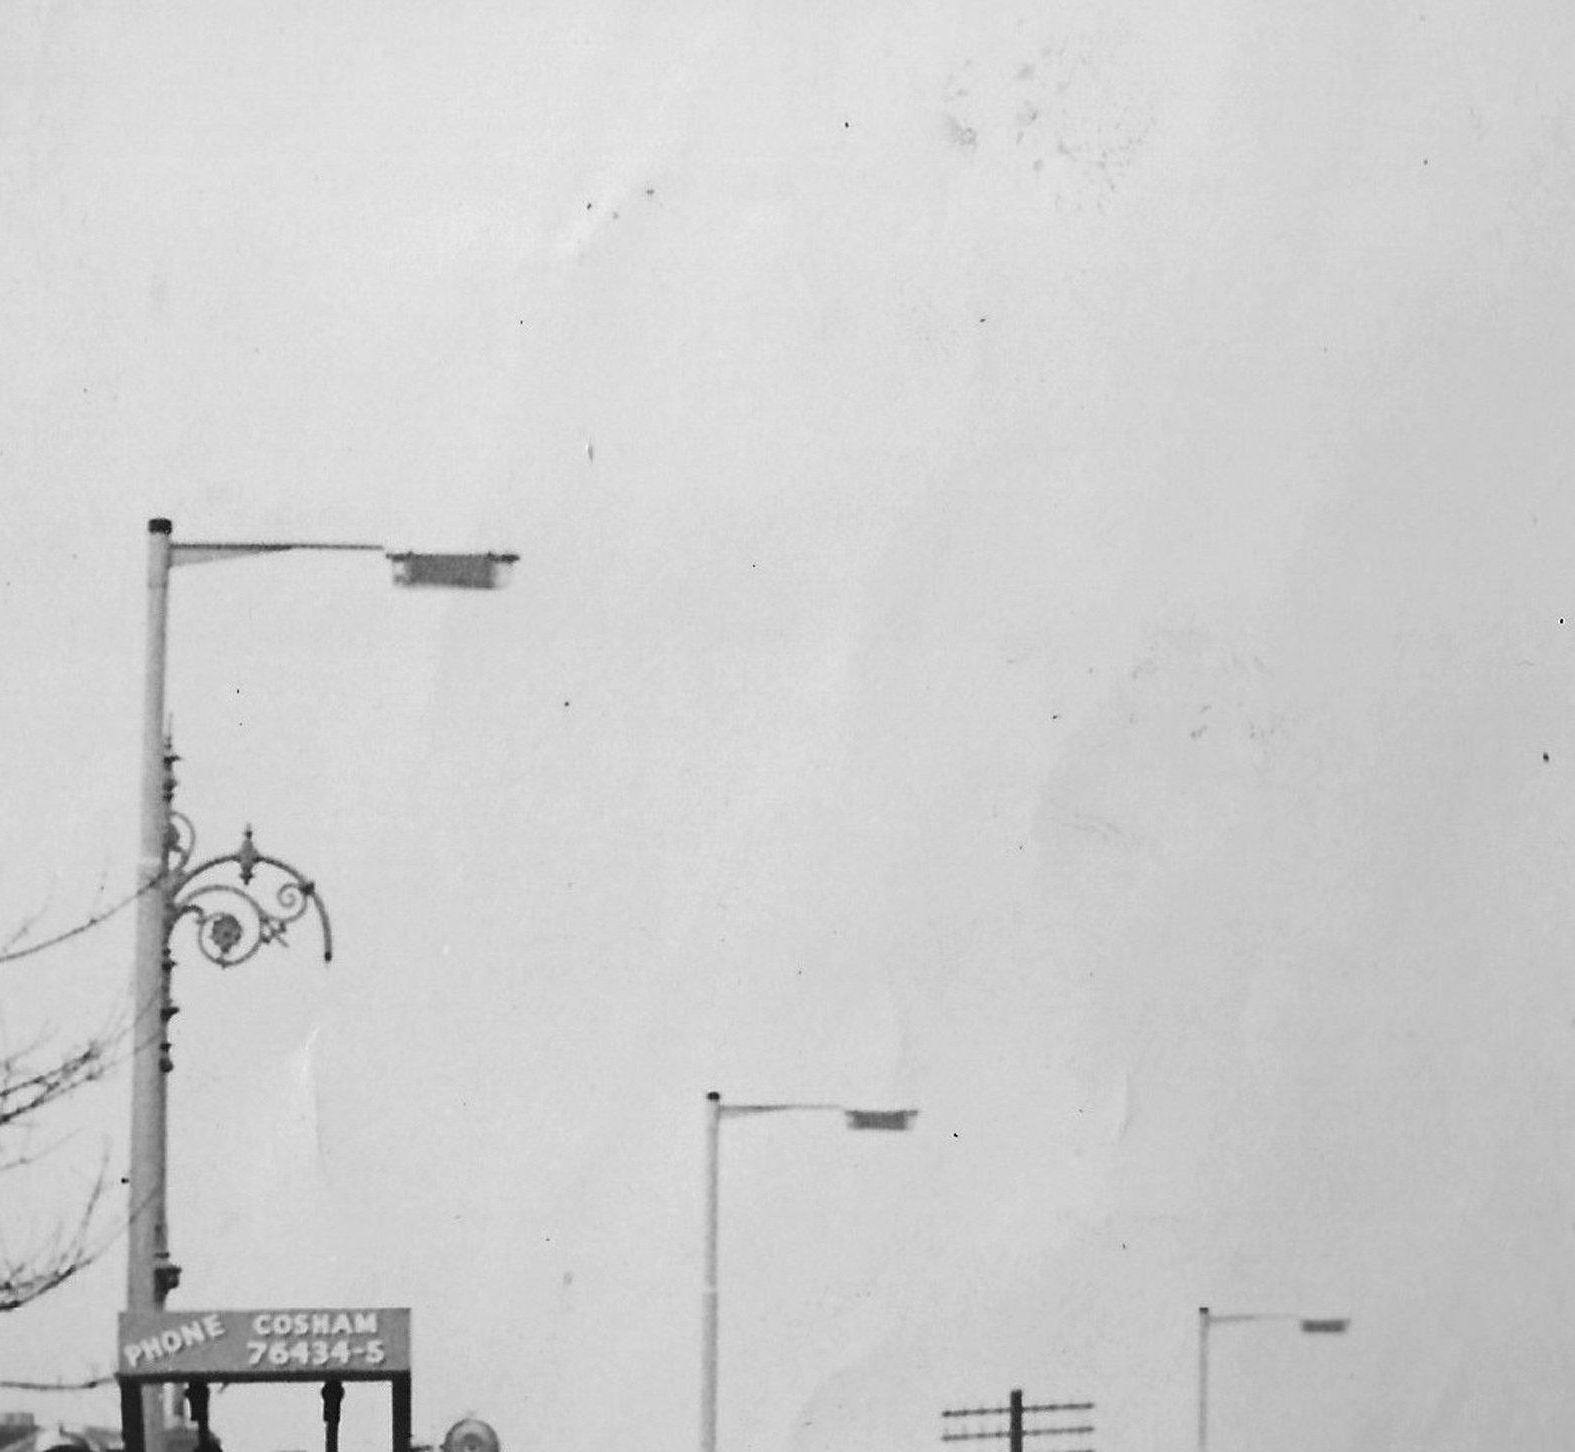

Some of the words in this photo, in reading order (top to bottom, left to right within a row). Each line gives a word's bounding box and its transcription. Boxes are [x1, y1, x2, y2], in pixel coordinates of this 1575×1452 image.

[252, 1312, 378, 1336] COSHAM
[123, 1313, 226, 1367] PHONE
[246, 1338, 386, 1366] 76434-5
